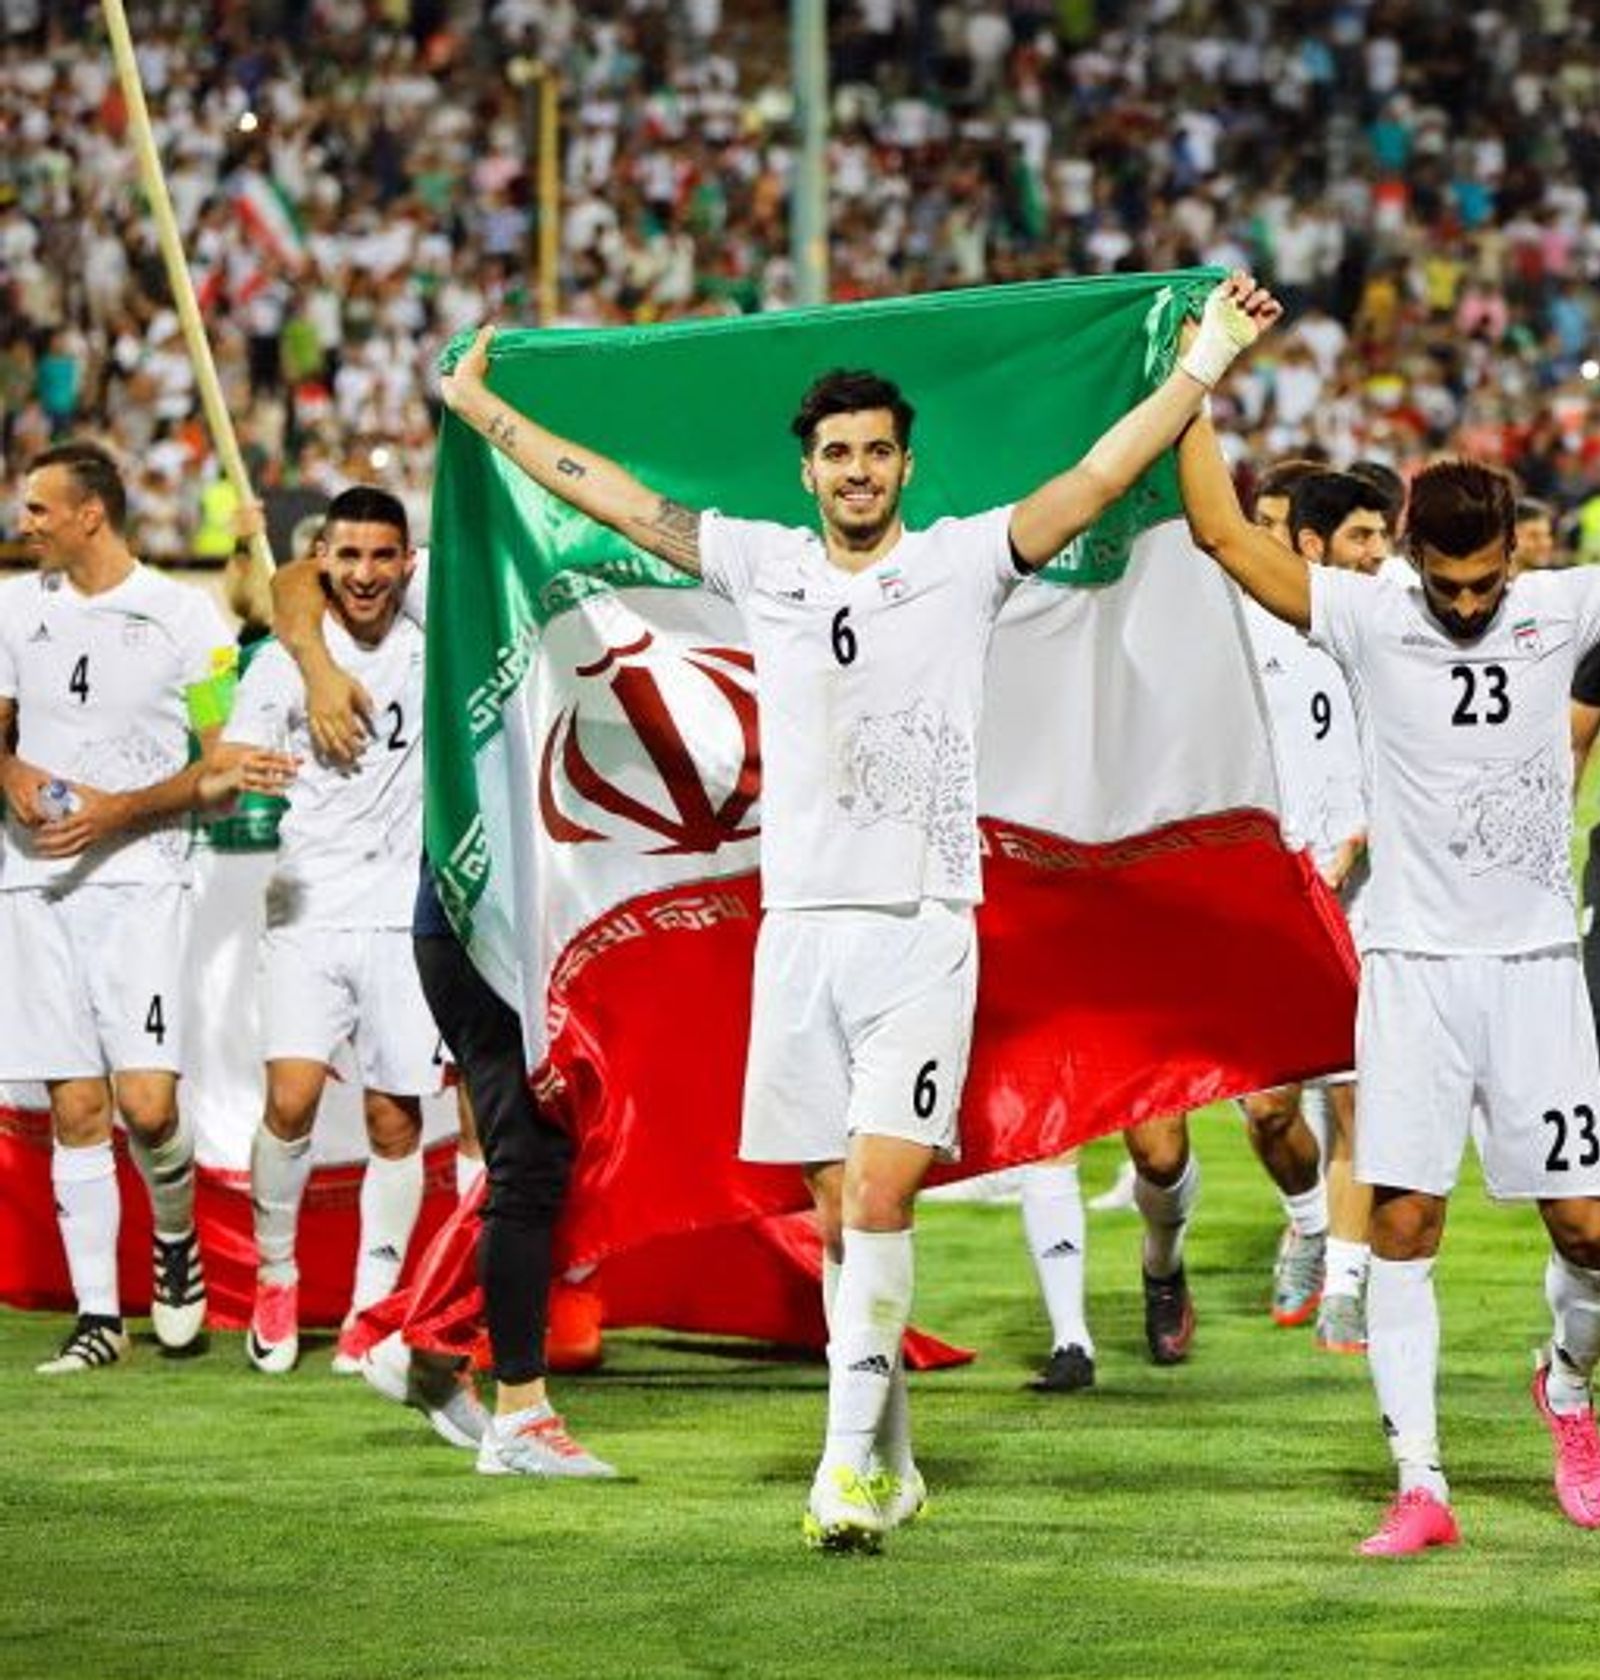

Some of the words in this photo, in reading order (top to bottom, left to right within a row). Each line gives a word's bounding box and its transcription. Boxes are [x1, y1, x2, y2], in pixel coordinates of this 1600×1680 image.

[831, 606, 857, 667] 6
[69, 655, 89, 703] 4
[1451, 665, 1511, 727] 23
[387, 701, 408, 751] 2
[1311, 691, 1331, 740] 9
[145, 994, 166, 1044] 4
[913, 1059, 938, 1119] 6
[1542, 1104, 1600, 1172] 23
